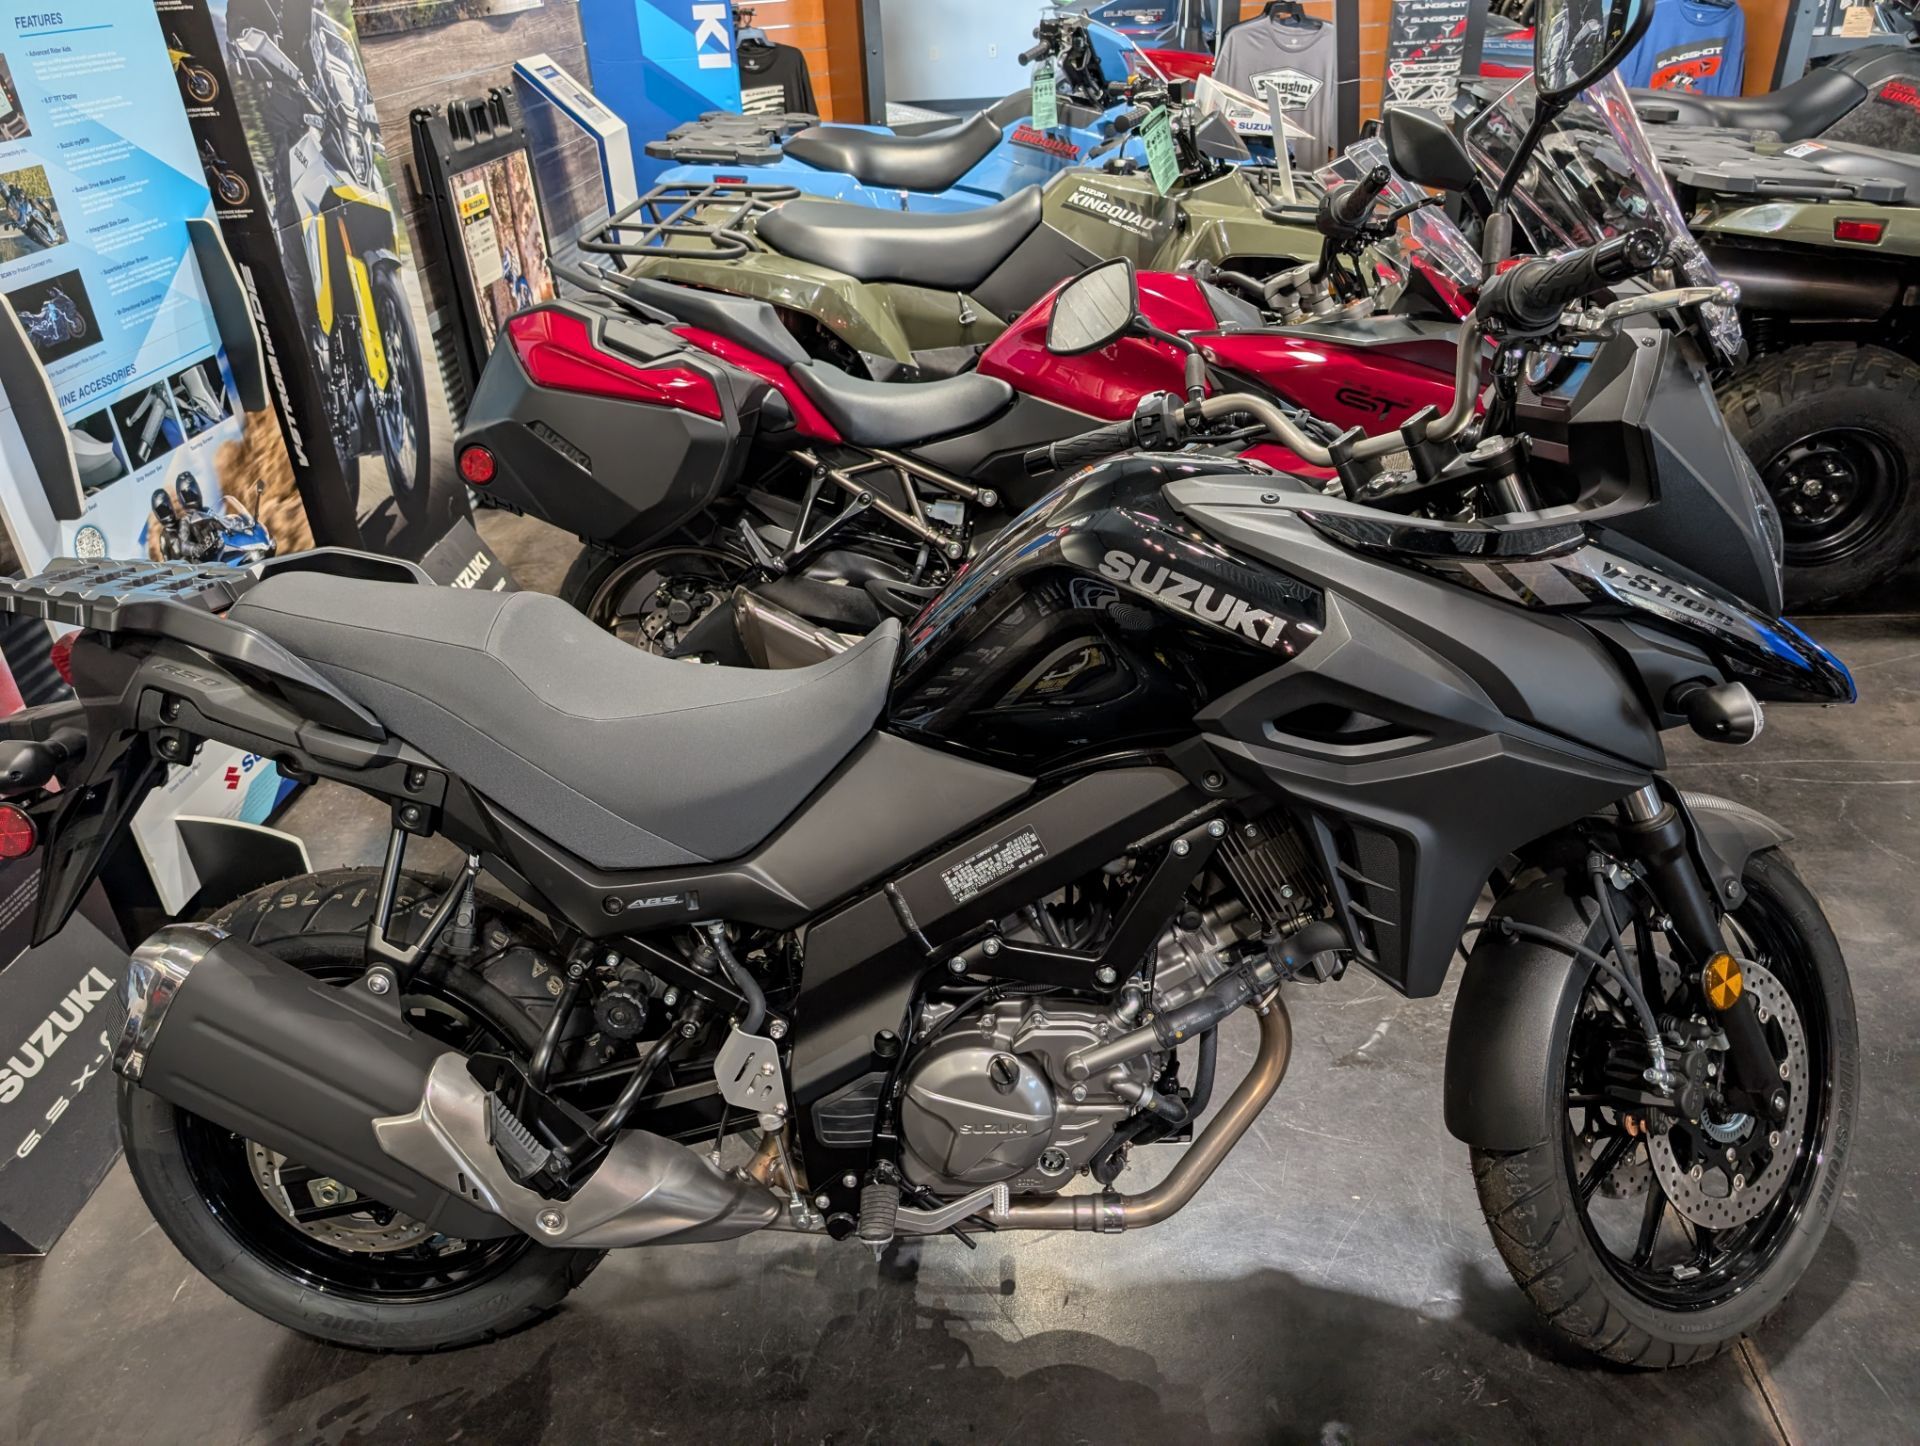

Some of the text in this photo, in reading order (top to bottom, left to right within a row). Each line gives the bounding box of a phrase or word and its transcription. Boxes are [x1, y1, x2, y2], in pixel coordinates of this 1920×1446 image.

[1410, 15, 1466, 24] SLINGSHOT
[1411, 1, 1468, 10] SLINGSHOT
[15, 12, 63, 29] FEATURES
[1657, 46, 1723, 69] SLINGSHOT
[1012, 131, 1081, 155] KINGQUAD
[1079, 185, 1108, 199] SUZUKI
[1067, 192, 1158, 230] KINGQUAD
[239, 262, 267, 324] DE
[79, 363, 137, 400] ACCESSORIES
[267, 354, 310, 467] V-STROM
[1335, 387, 1410, 421] GT
[534, 422, 590, 468] SUZUKI
[1098, 550, 1288, 648] SUZUKI
[1602, 561, 1734, 627] V-Strom
[152, 664, 222, 687] 650
[627, 895, 679, 909] ABS
[0, 966, 114, 1104] SUZUKI
[960, 1123, 1028, 1135] SUZUKI
